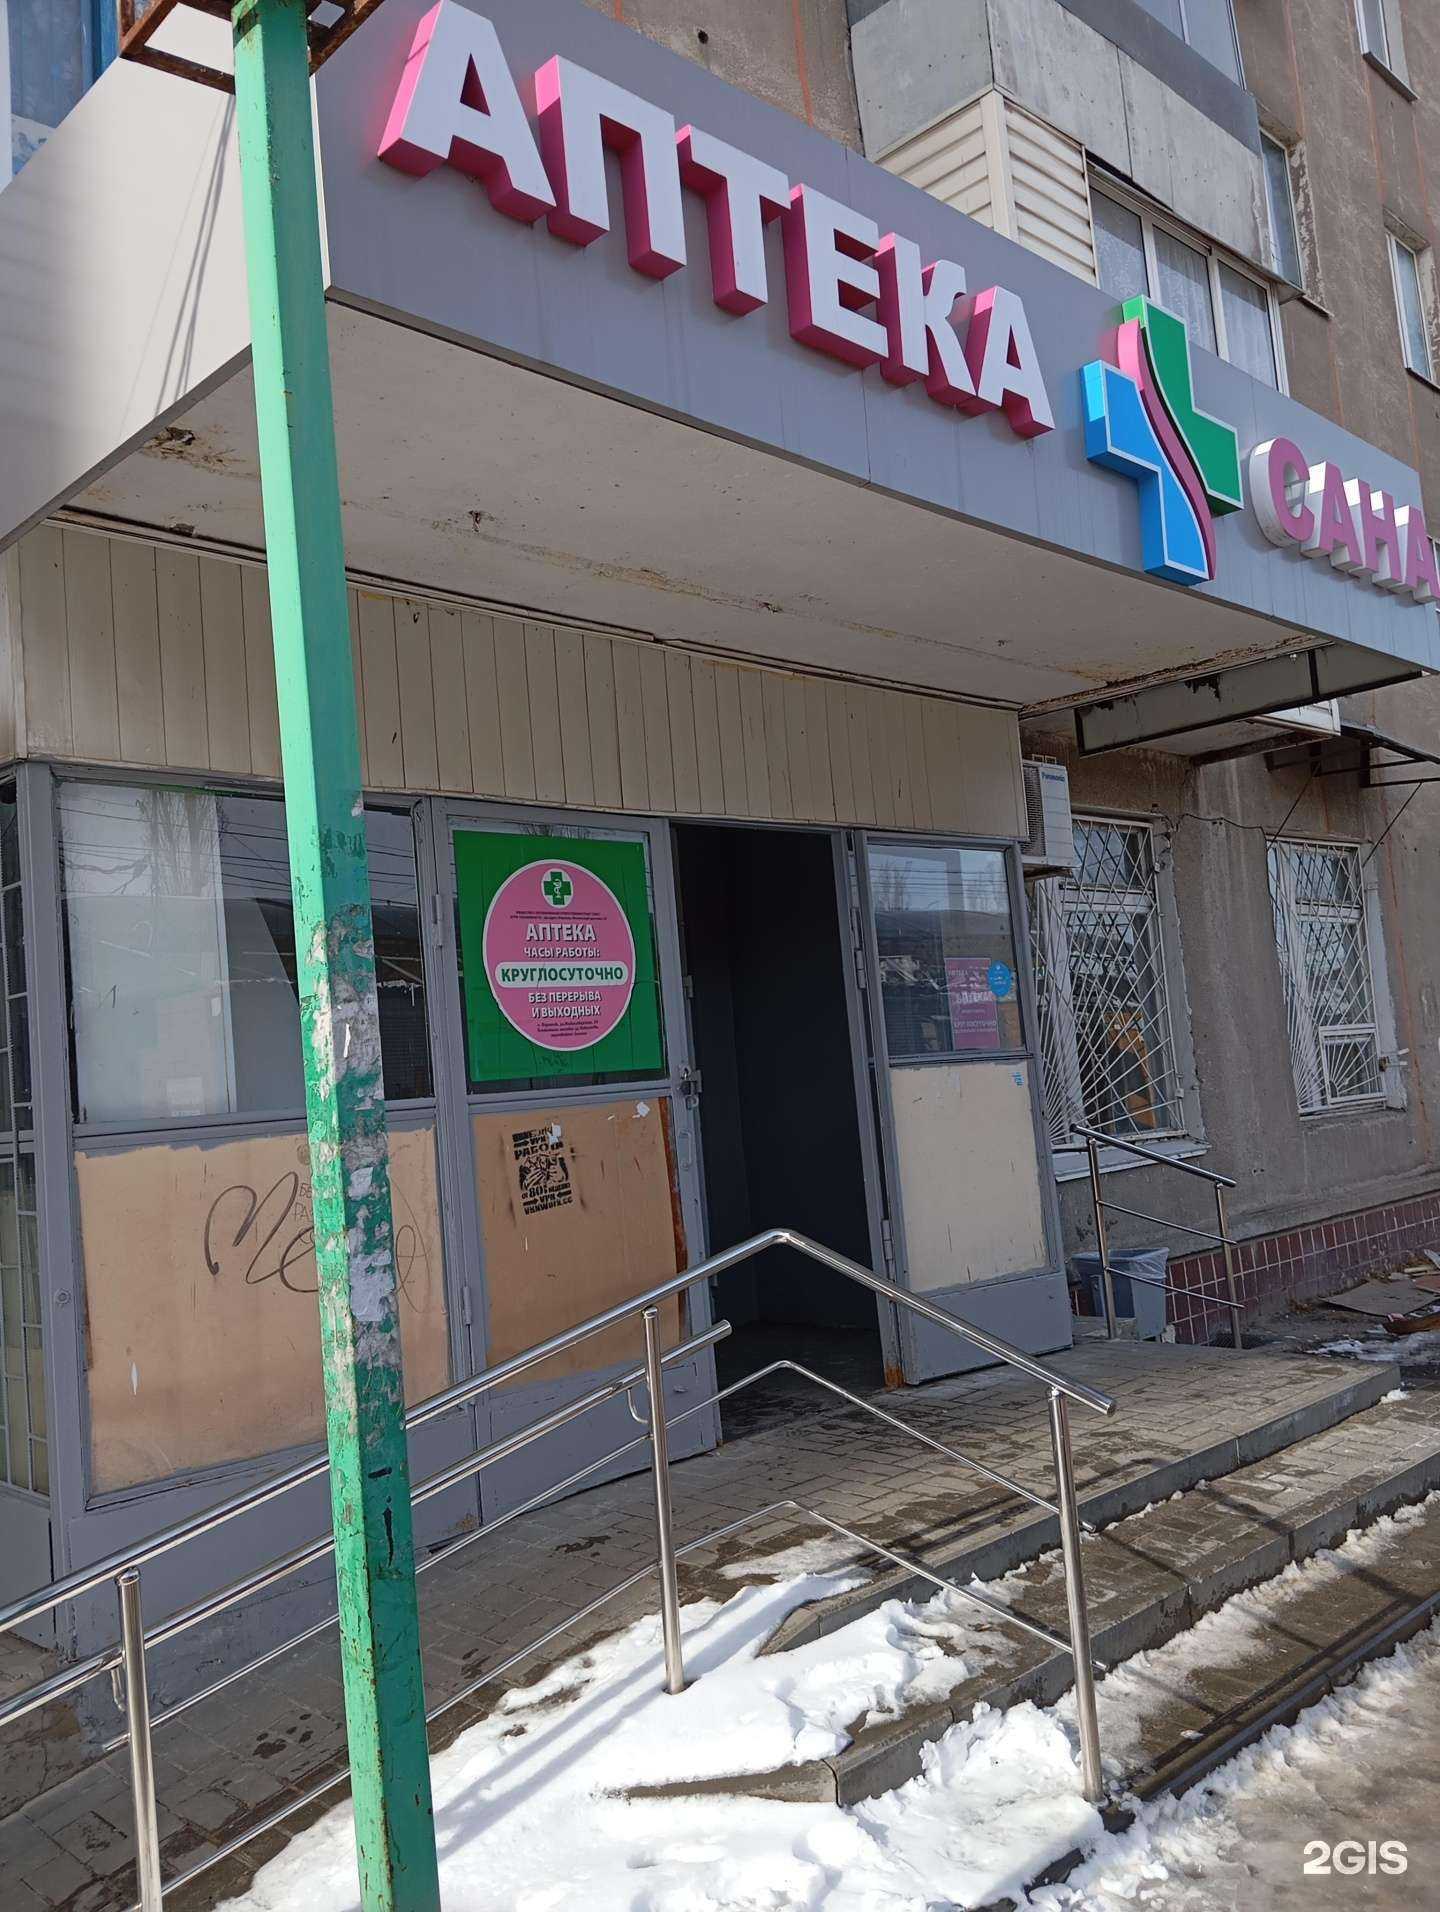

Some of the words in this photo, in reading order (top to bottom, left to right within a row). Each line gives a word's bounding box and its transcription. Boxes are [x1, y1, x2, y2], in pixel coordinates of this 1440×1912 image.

[378, 0, 1055, 438] АПТЕКА
[1251, 437, 1440, 604] САНА
[526, 923, 597, 942] АПТЕКА
[524, 947, 553, 958] ЧАСЫ
[555, 947, 601, 958] РАБОТЫ:
[501, 966, 624, 982] КРУГЛОСУТОЧНО
[528, 992, 547, 1003] БЕЗ
[549, 991, 602, 1002] ПЕРЕРЫВА
[532, 1008, 540, 1018] И
[542, 1005, 601, 1018] ВЫХОДНЫХ
